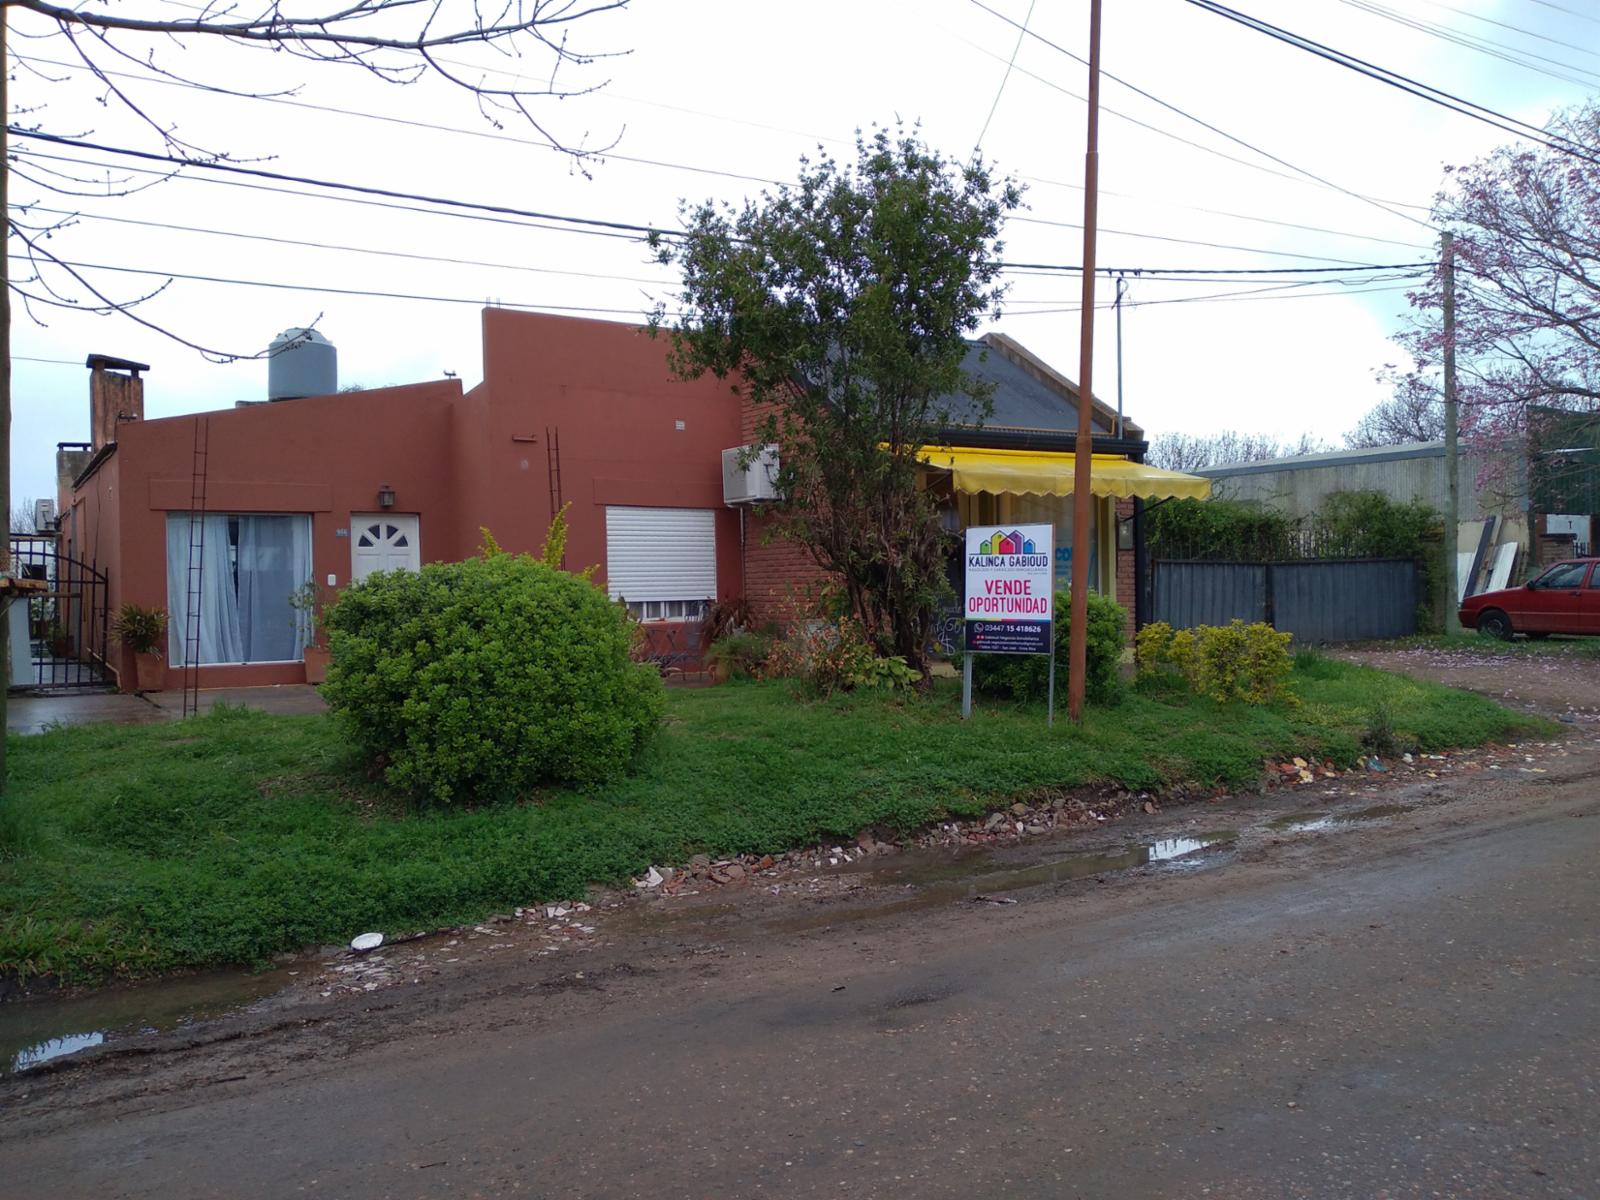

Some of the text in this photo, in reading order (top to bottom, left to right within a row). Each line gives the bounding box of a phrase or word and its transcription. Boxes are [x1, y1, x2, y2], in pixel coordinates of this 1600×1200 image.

[968, 555, 1049, 568] KALINCA GABIOUD
[984, 579, 1032, 596] VENDE
[968, 596, 1048, 614] OPORTUNIDAD
[984, 624, 1005, 632] 03447
[1016, 625, 1042, 633] 418626
